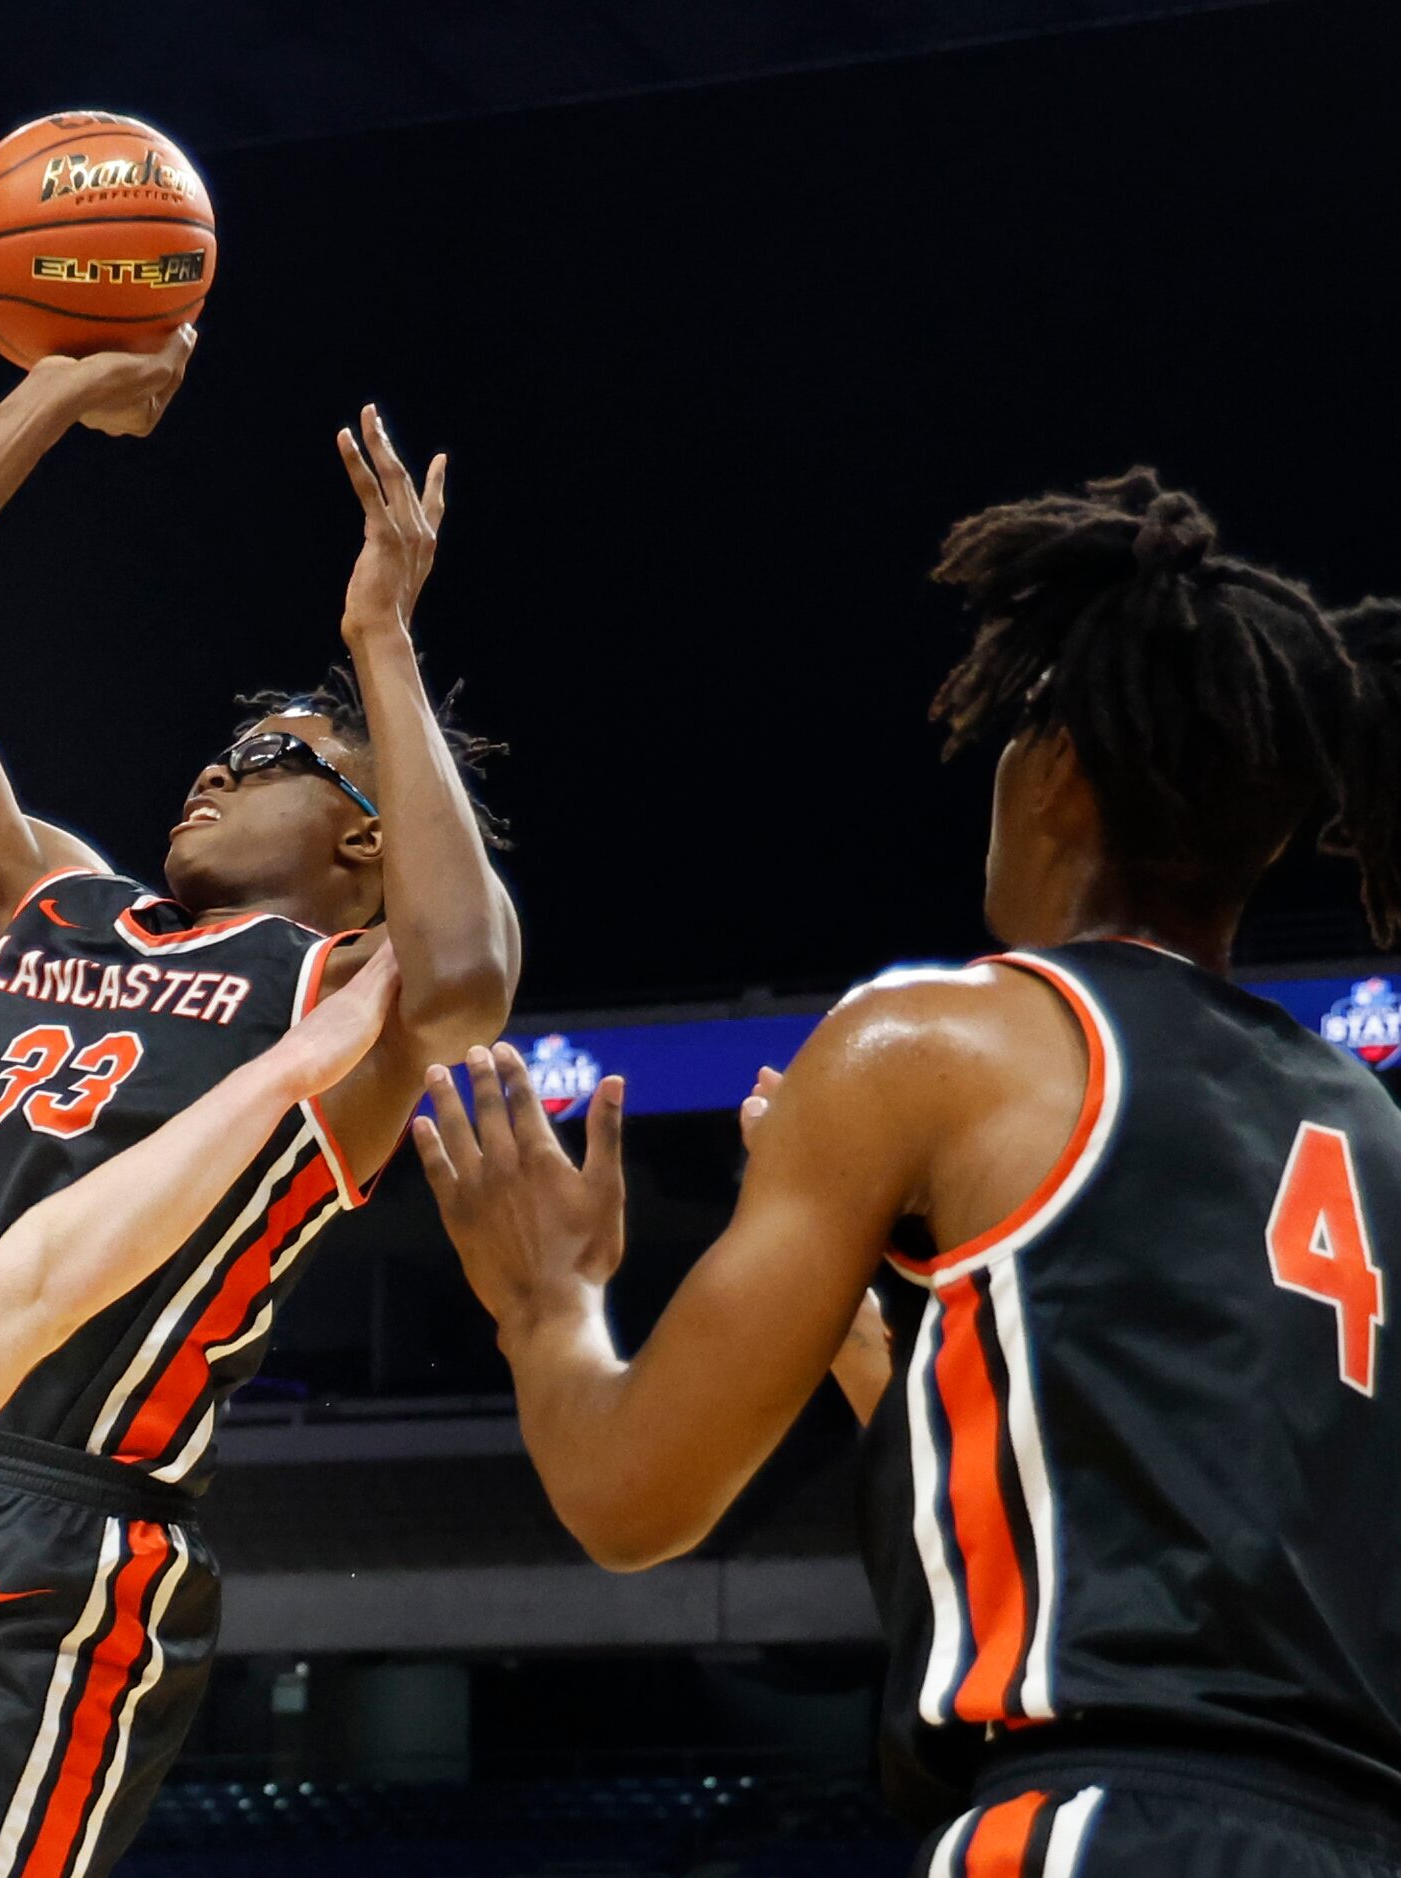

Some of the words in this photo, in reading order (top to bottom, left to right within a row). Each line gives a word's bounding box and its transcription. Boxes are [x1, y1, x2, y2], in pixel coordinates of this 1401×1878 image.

[74, 189, 184, 205] PERFECTION
[32, 256, 163, 284] ELITE
[1324, 1011, 1401, 1045] STAT
[1265, 1120, 1385, 1399] 4
